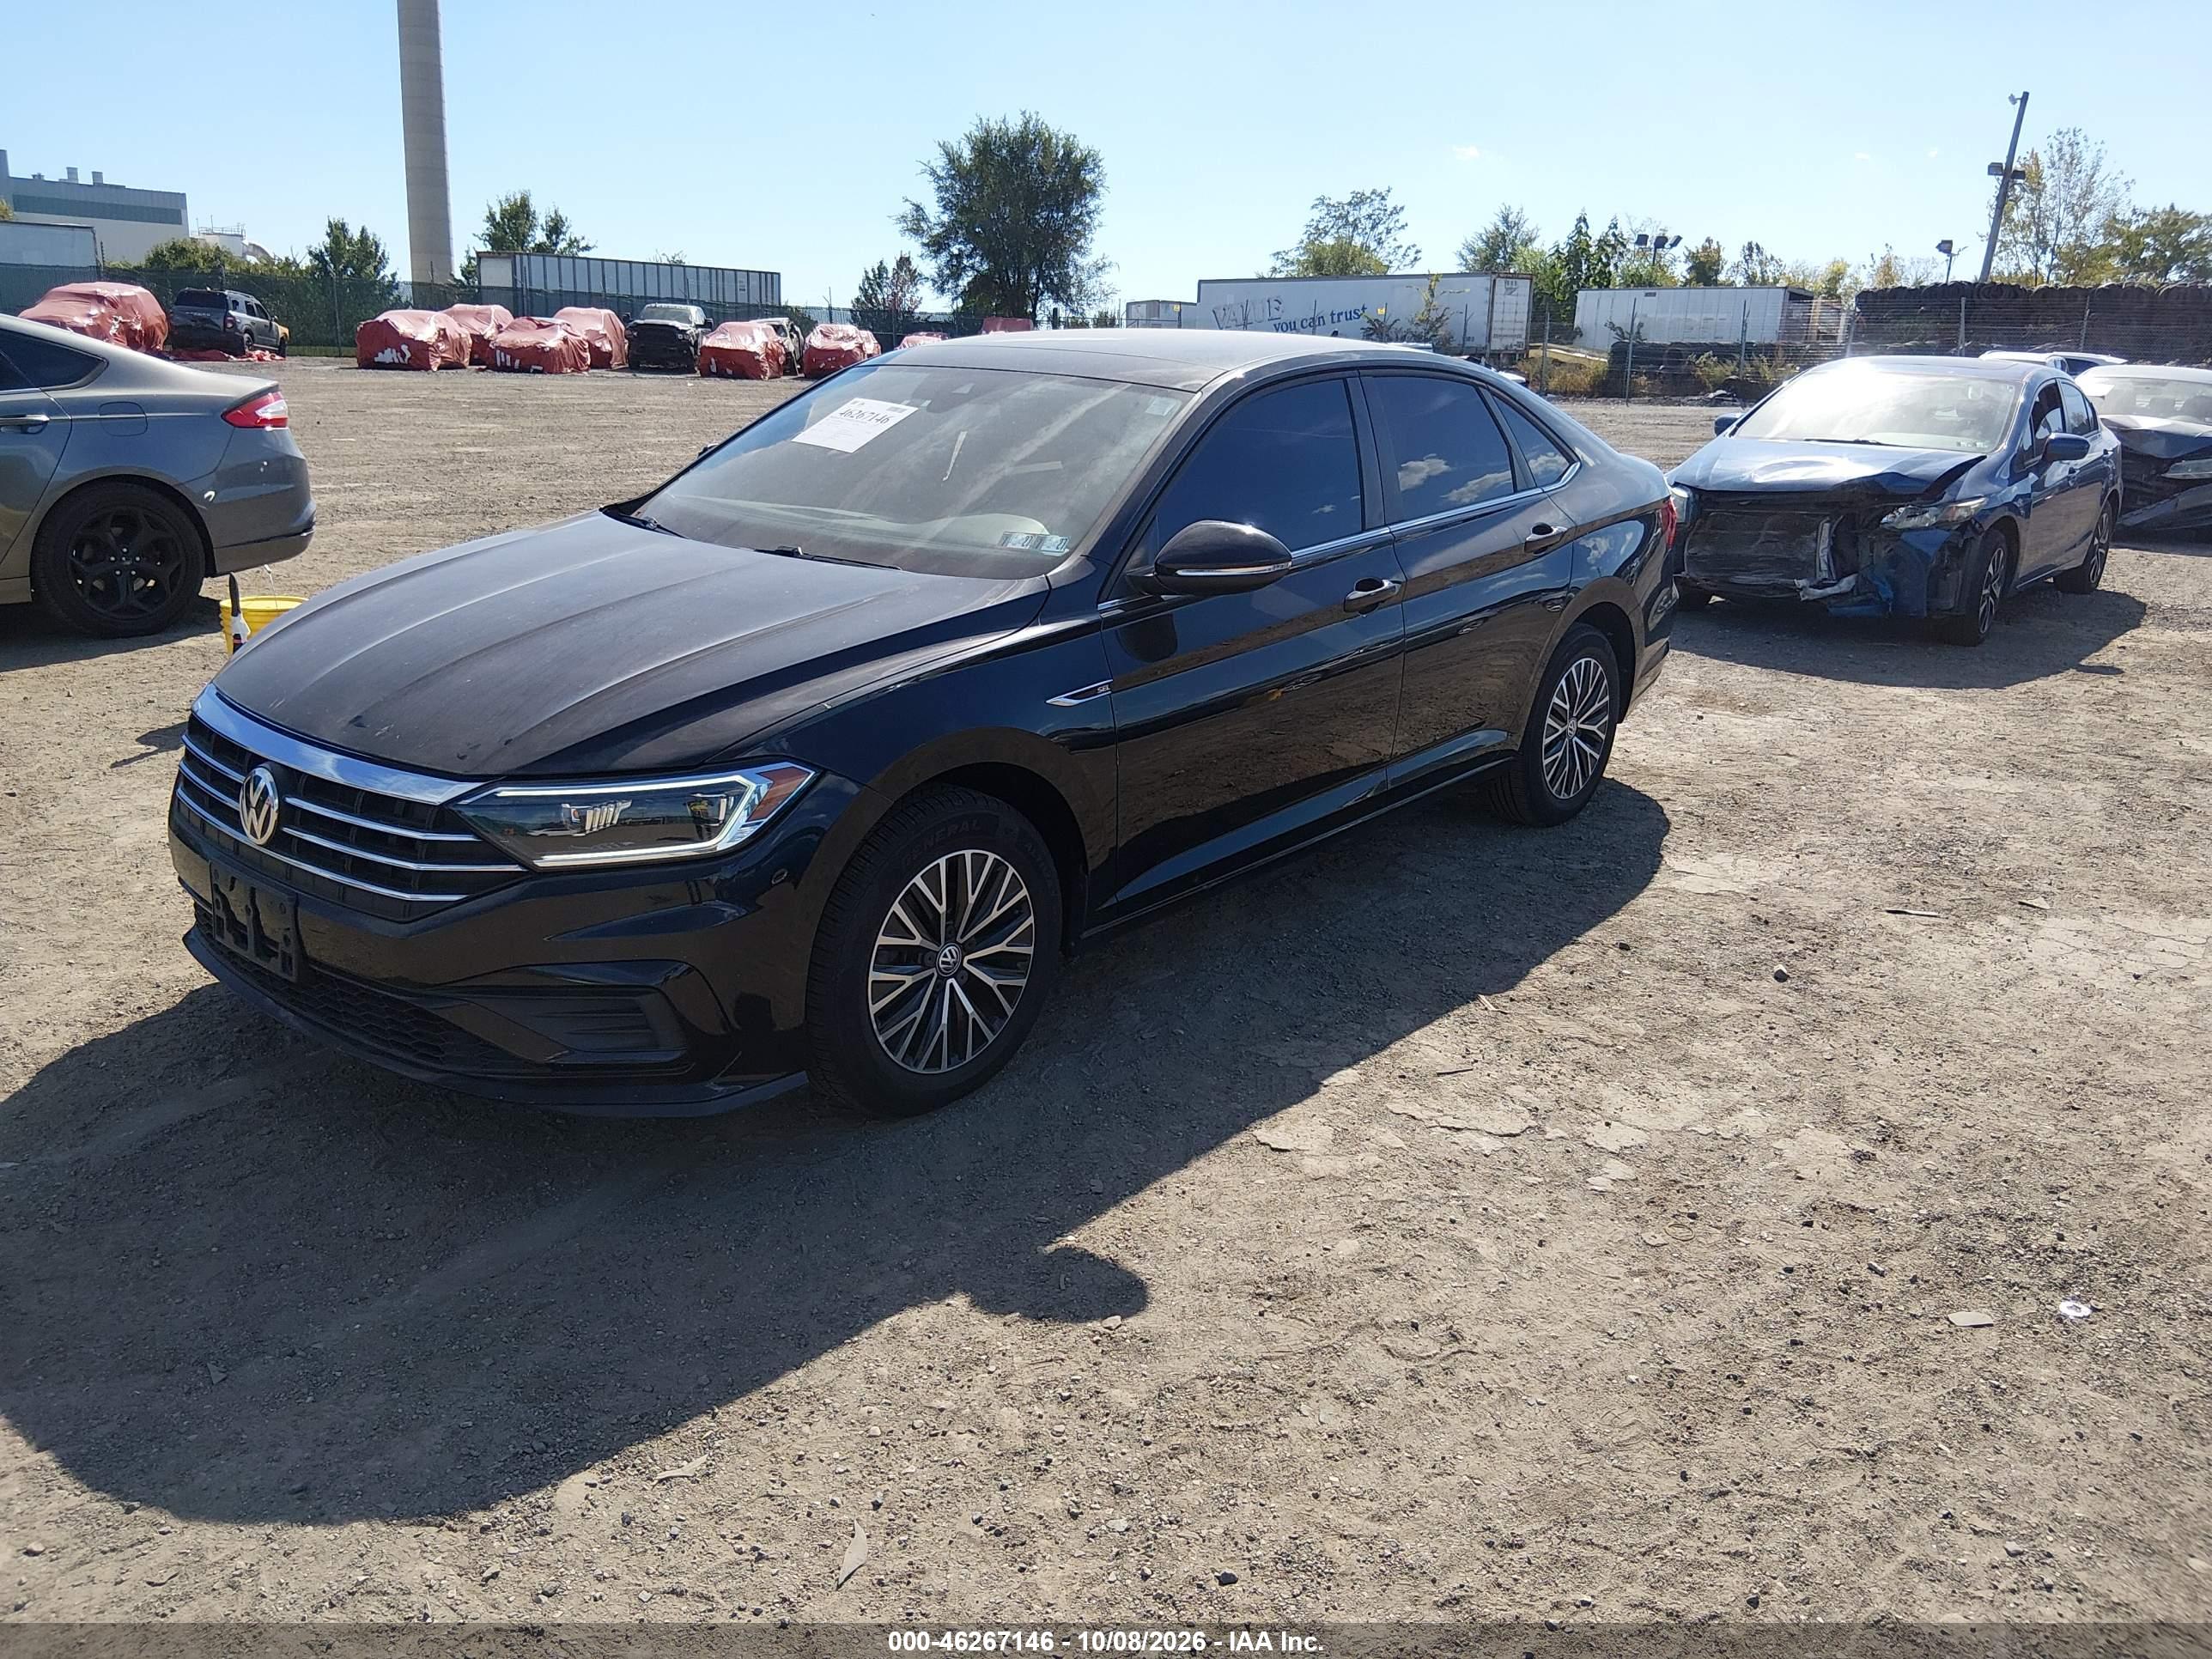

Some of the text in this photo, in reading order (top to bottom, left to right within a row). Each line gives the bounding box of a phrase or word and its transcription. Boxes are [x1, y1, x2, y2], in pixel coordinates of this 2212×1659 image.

[1273, 303, 1367, 333] you can trust
[839, 409, 891, 424] 46267146
[1097, 684, 1110, 693] SEL
